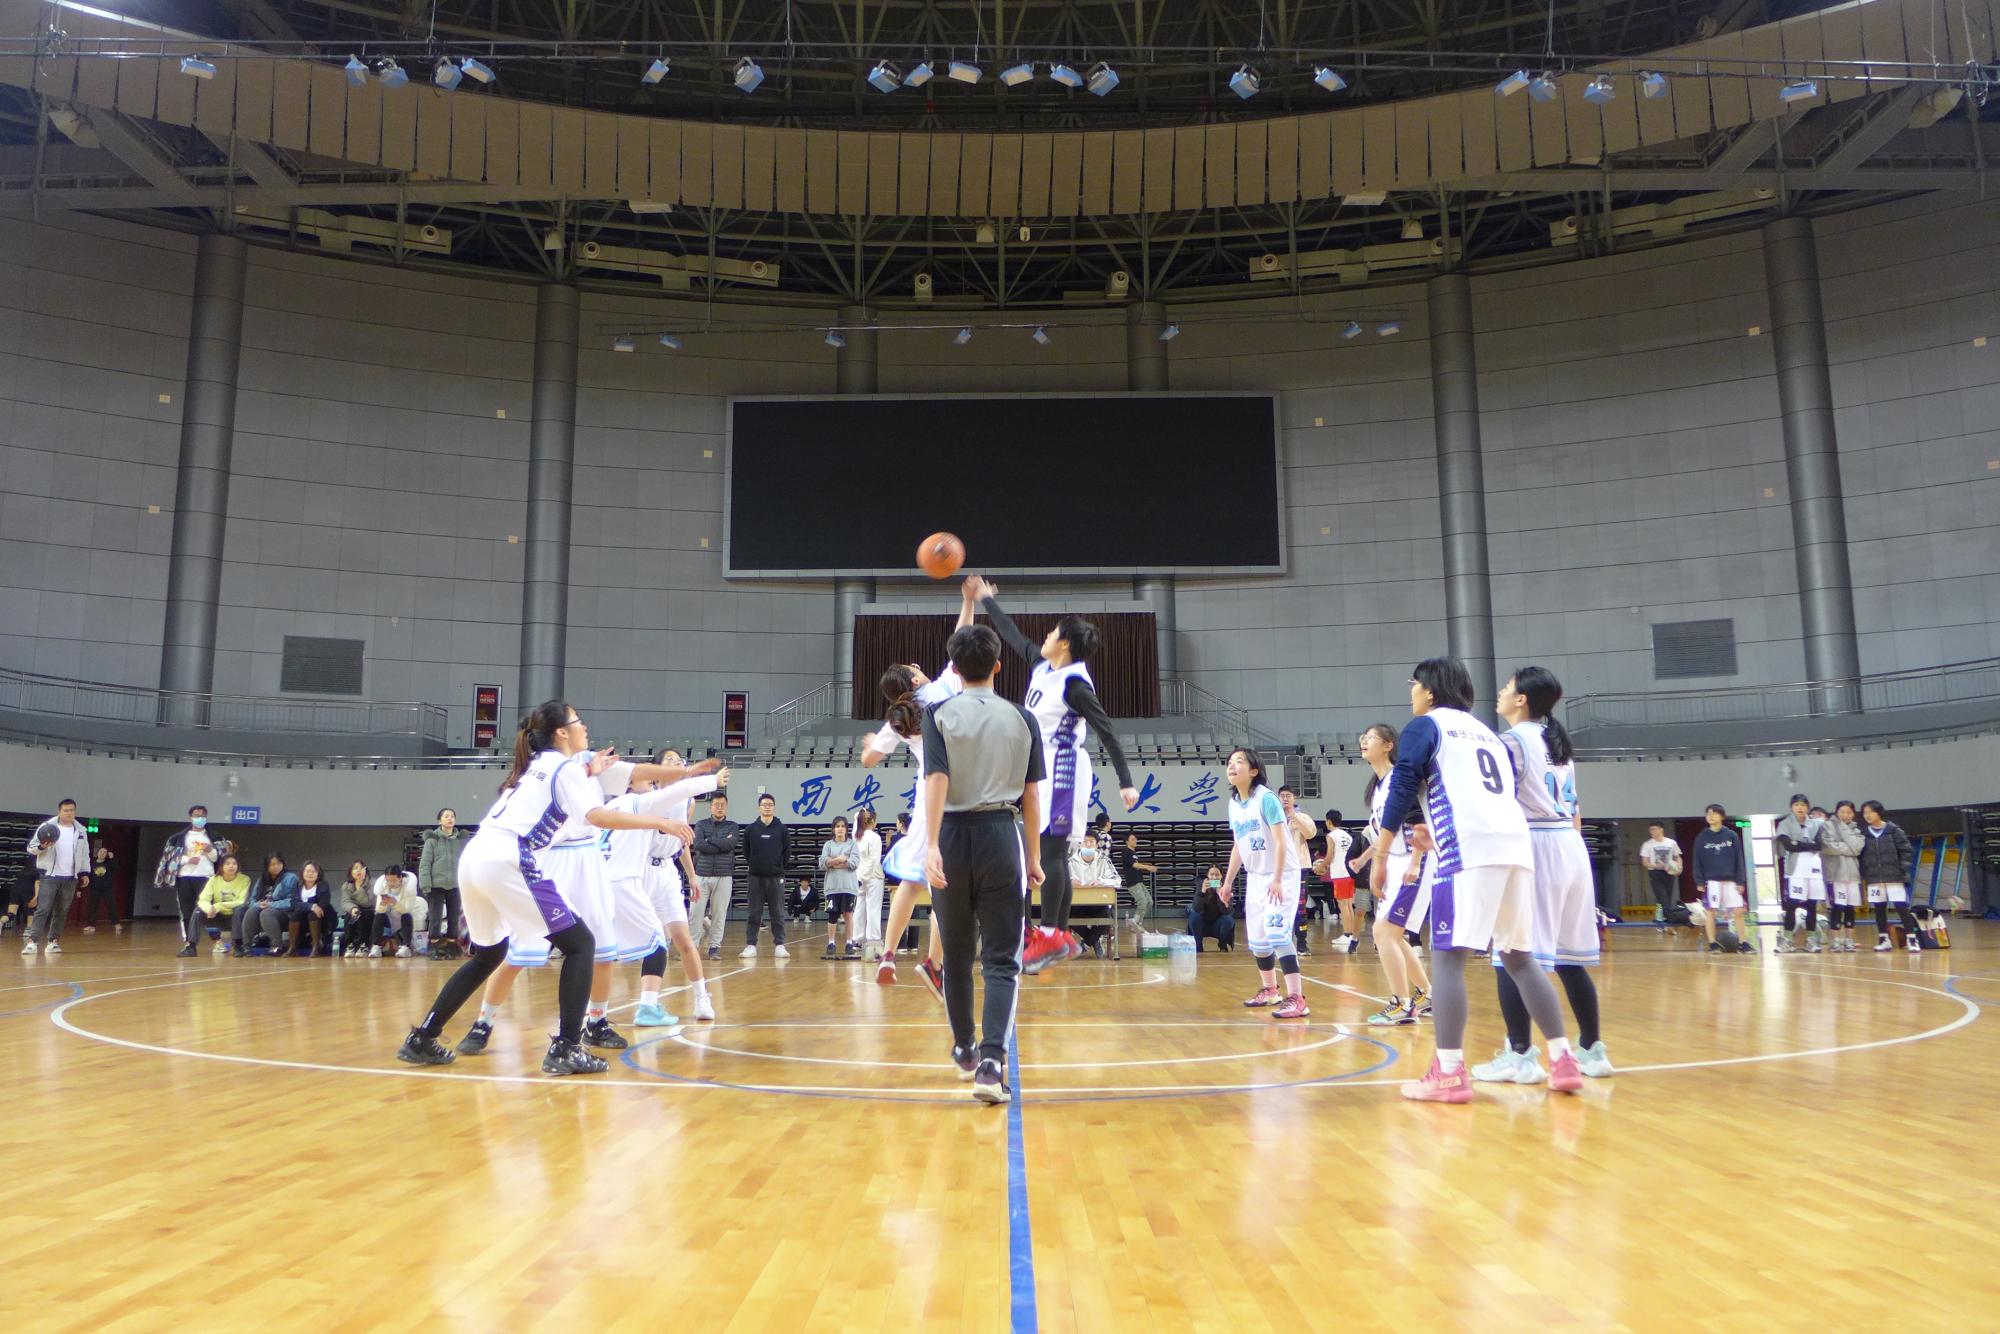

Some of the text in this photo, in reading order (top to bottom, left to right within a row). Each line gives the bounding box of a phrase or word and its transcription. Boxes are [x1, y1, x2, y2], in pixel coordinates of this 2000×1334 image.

[1026, 688, 1043, 708] 10
[1476, 747, 1504, 795] 9
[1544, 771, 1578, 817] 14
[235, 809, 257, 820] 出口
[1249, 837, 1266, 851] 22
[1266, 913, 1283, 927] 22
